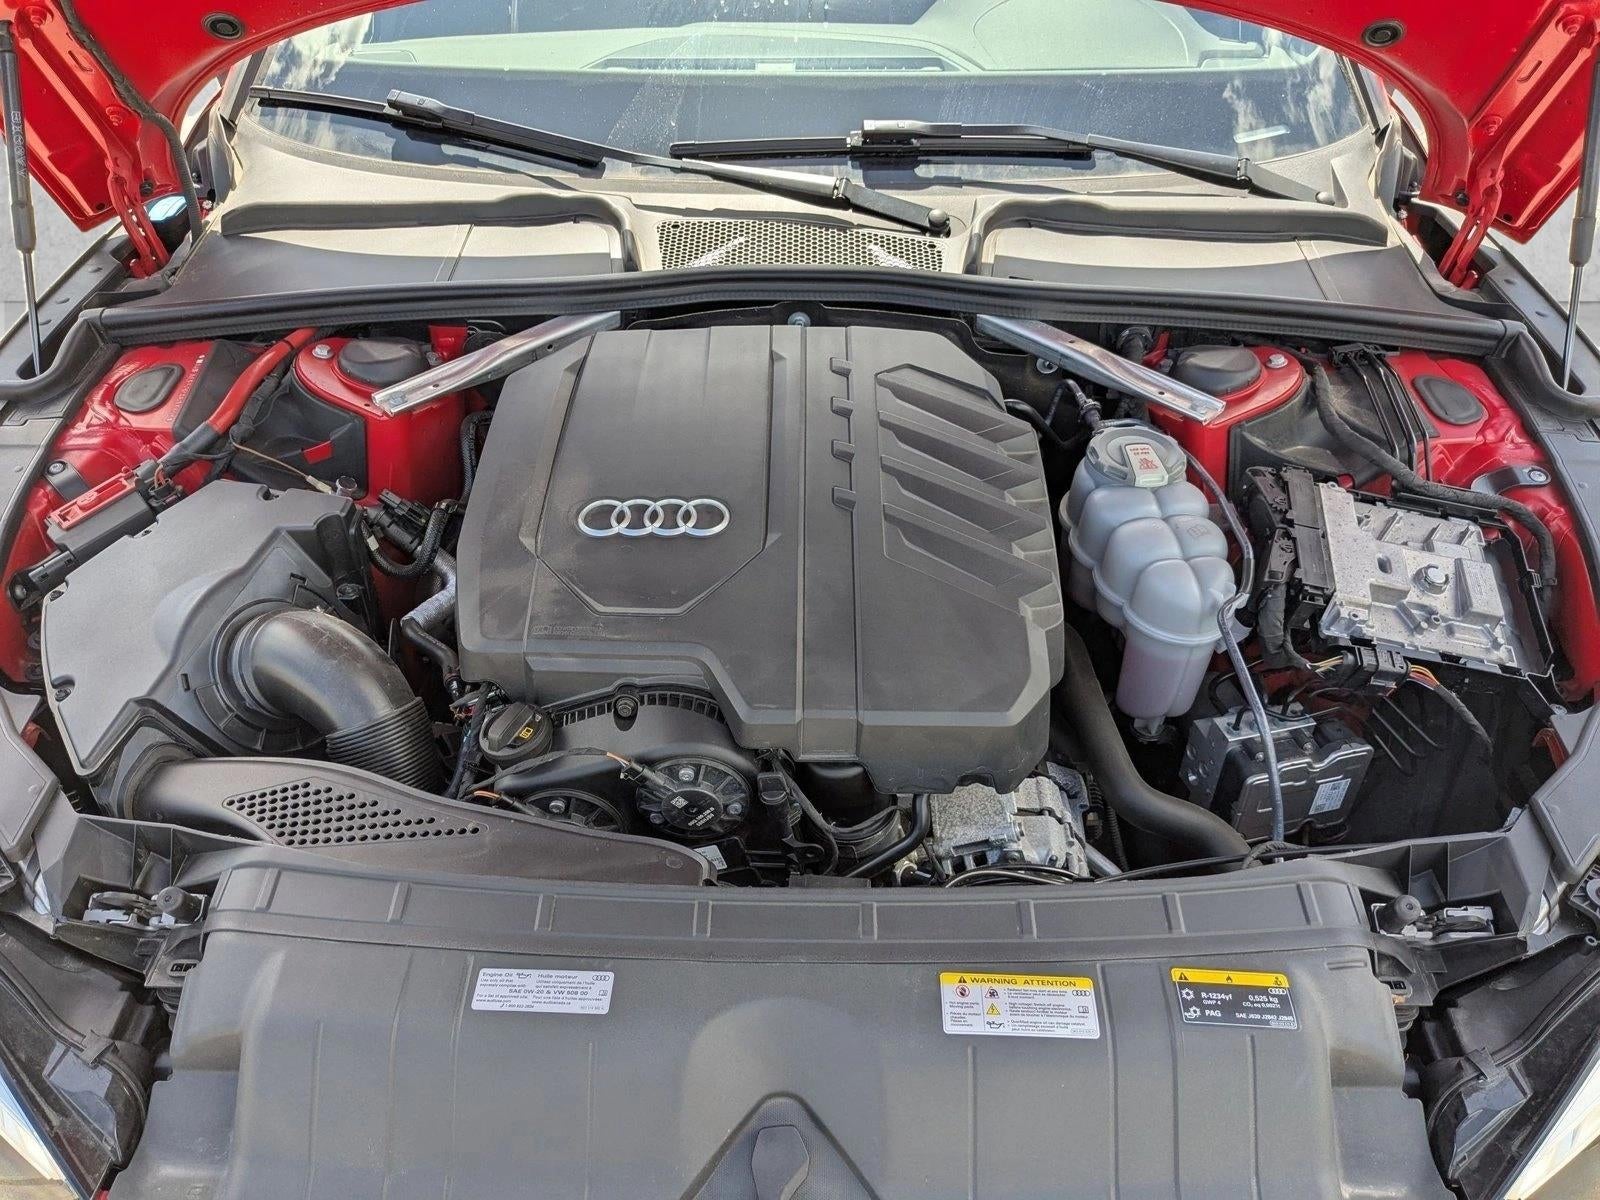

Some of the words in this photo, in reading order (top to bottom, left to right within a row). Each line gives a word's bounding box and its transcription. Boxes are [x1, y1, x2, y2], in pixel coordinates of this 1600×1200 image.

[970, 977, 1018, 985] WARNING
[1023, 979, 1077, 987] ATTENTION
[1201, 991, 1232, 1001] R-1234yf
[1248, 994, 1268, 1002] 0,525
[1269, 995, 1279, 1004] kg
[1205, 1009, 1221, 1017] PAG
